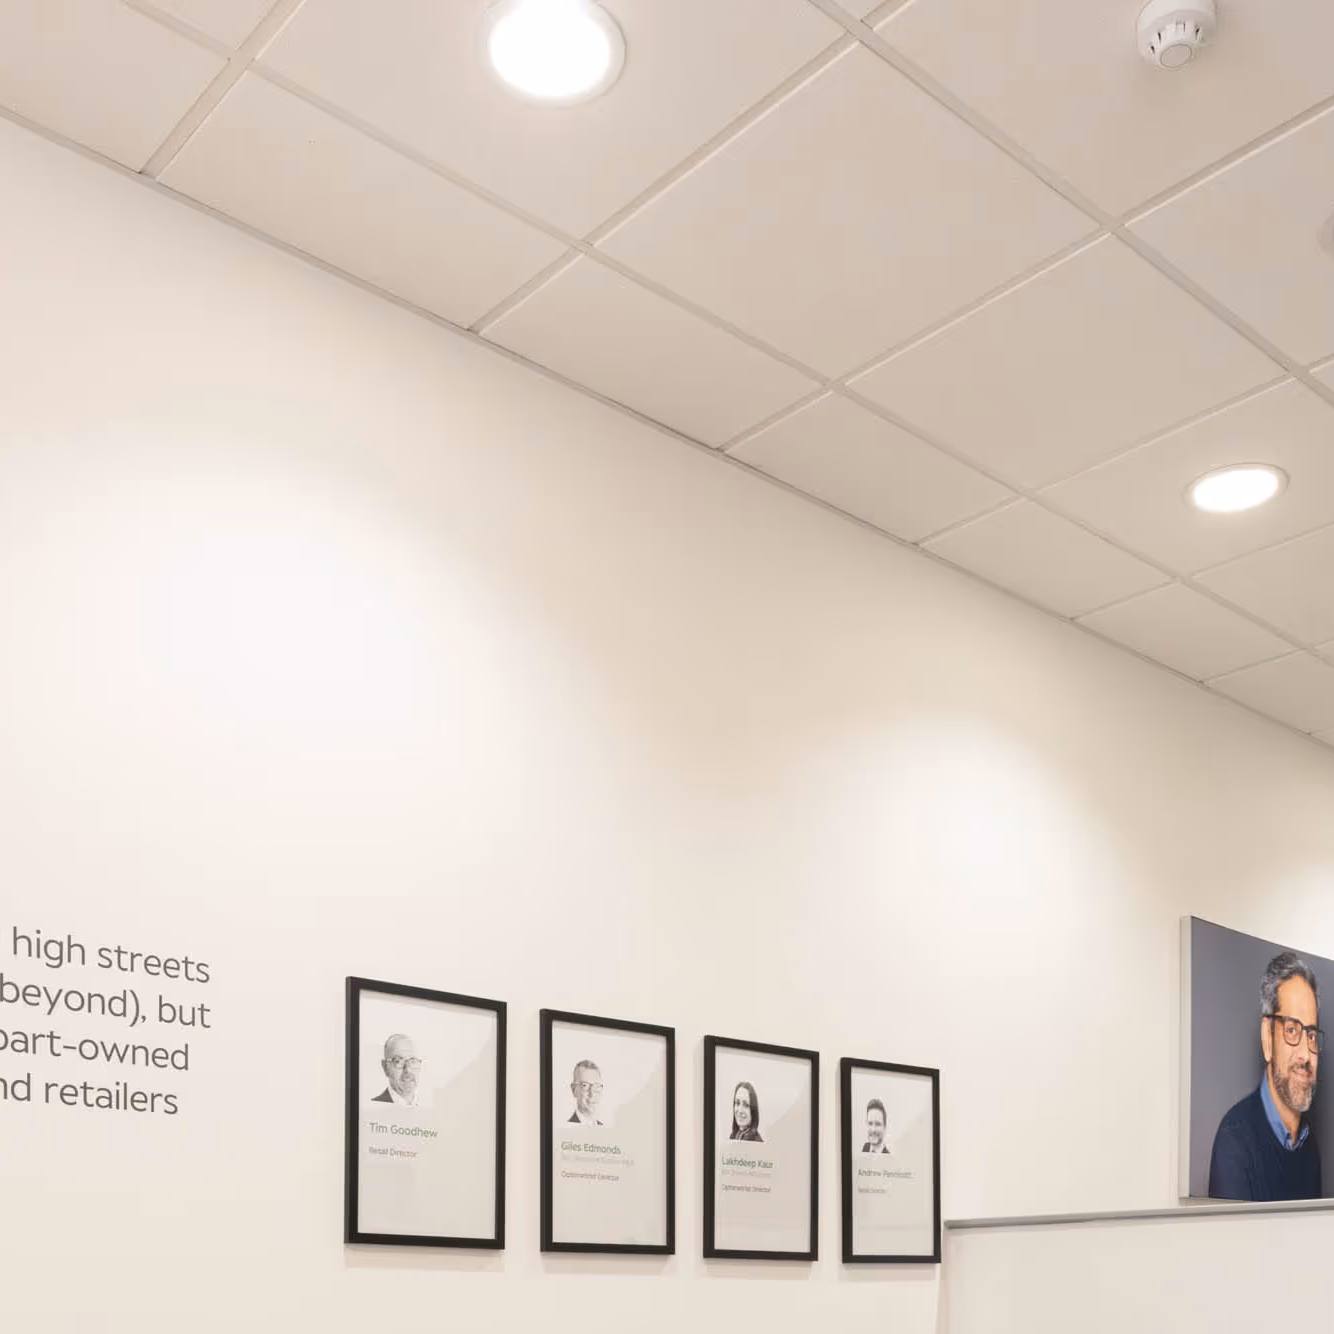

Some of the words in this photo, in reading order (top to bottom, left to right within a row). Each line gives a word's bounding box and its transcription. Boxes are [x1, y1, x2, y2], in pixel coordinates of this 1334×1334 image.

[13, 926, 85, 968] high
[98, 945, 210, 983] streets
[0, 973, 146, 1027] beyond),
[159, 995, 211, 1028] but
[45, 1081, 178, 1114] retailers
[370, 1122, 388, 1134] Tim
[390, 1125, 438, 1138] Goodhew
[561, 1141, 581, 1152] Giles
[583, 1143, 621, 1155] Edmonds
